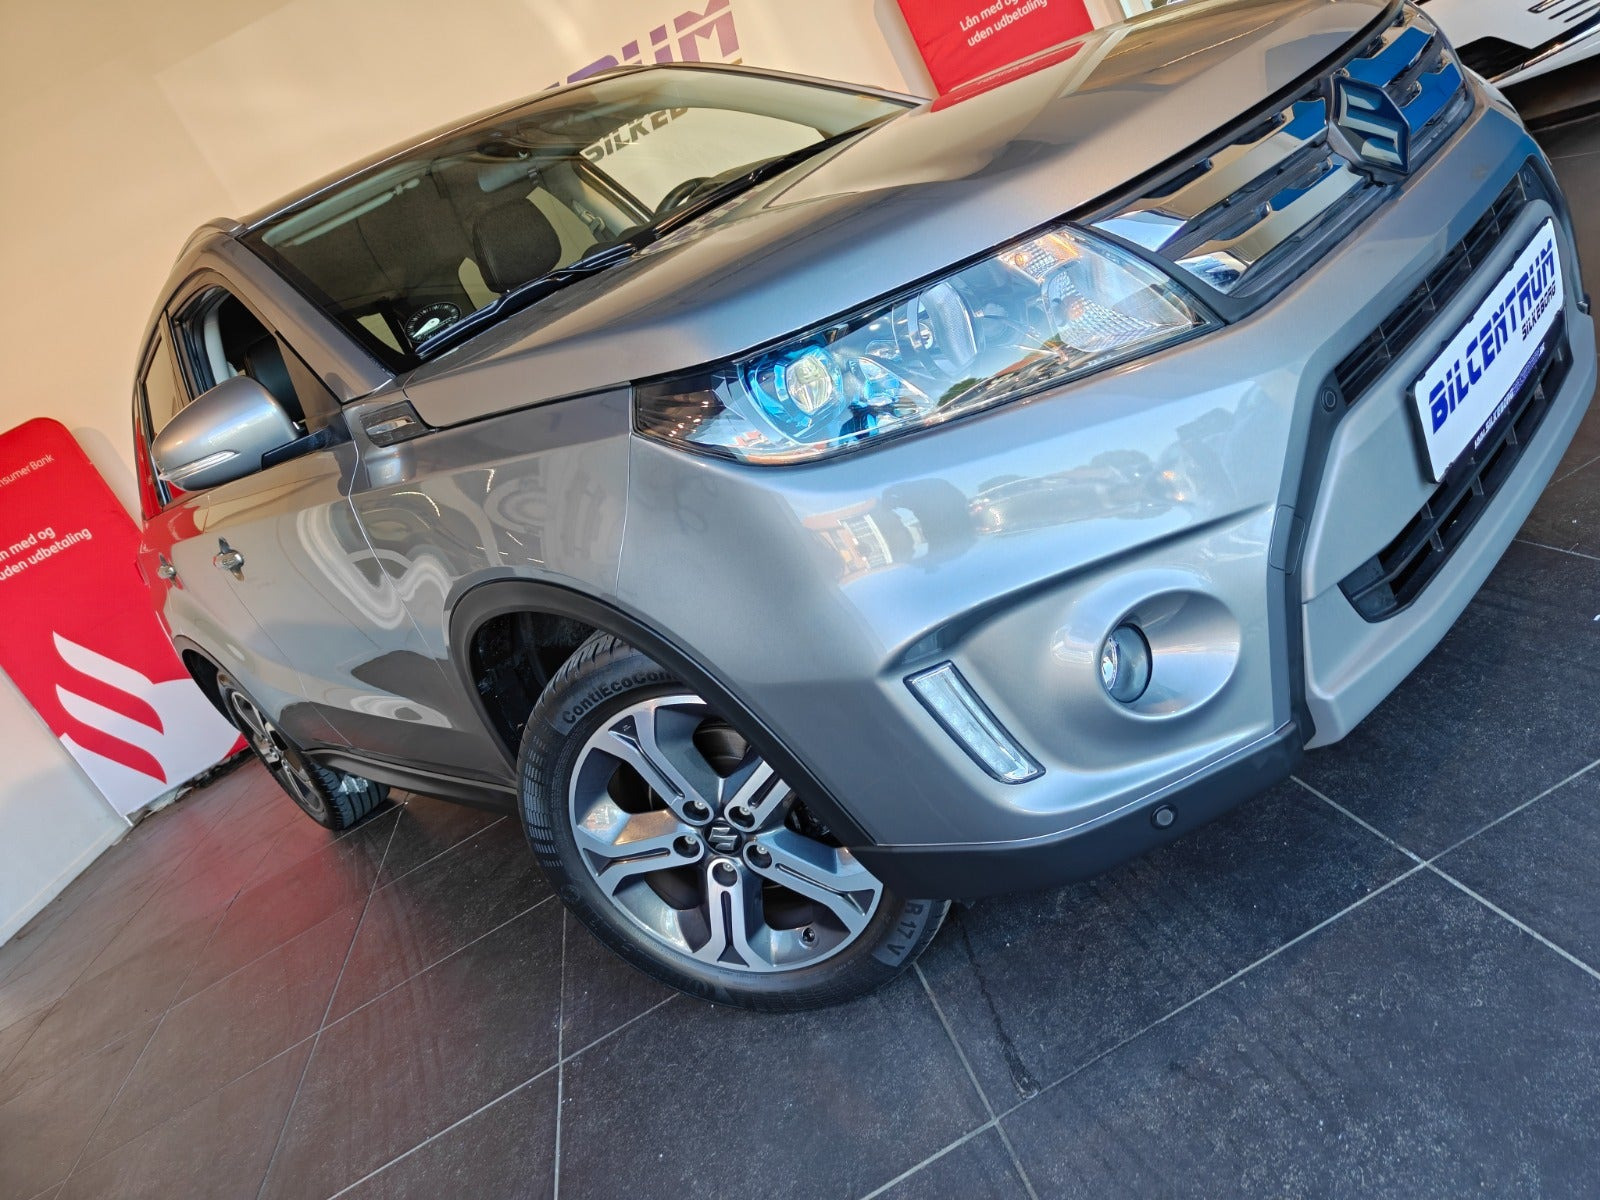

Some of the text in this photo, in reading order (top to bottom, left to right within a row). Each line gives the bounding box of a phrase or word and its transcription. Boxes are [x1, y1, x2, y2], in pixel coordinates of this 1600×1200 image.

[960, 15, 980, 31] Lån
[980, 0, 1004, 20] med
[967, 0, 1048, 47] uden udbetaling
[29, 454, 55, 470] Bank
[9, 533, 38, 555] med
[37, 527, 56, 540] og
[27, 528, 92, 565] udbetaling
[887, 902, 924, 956] R 17 V
